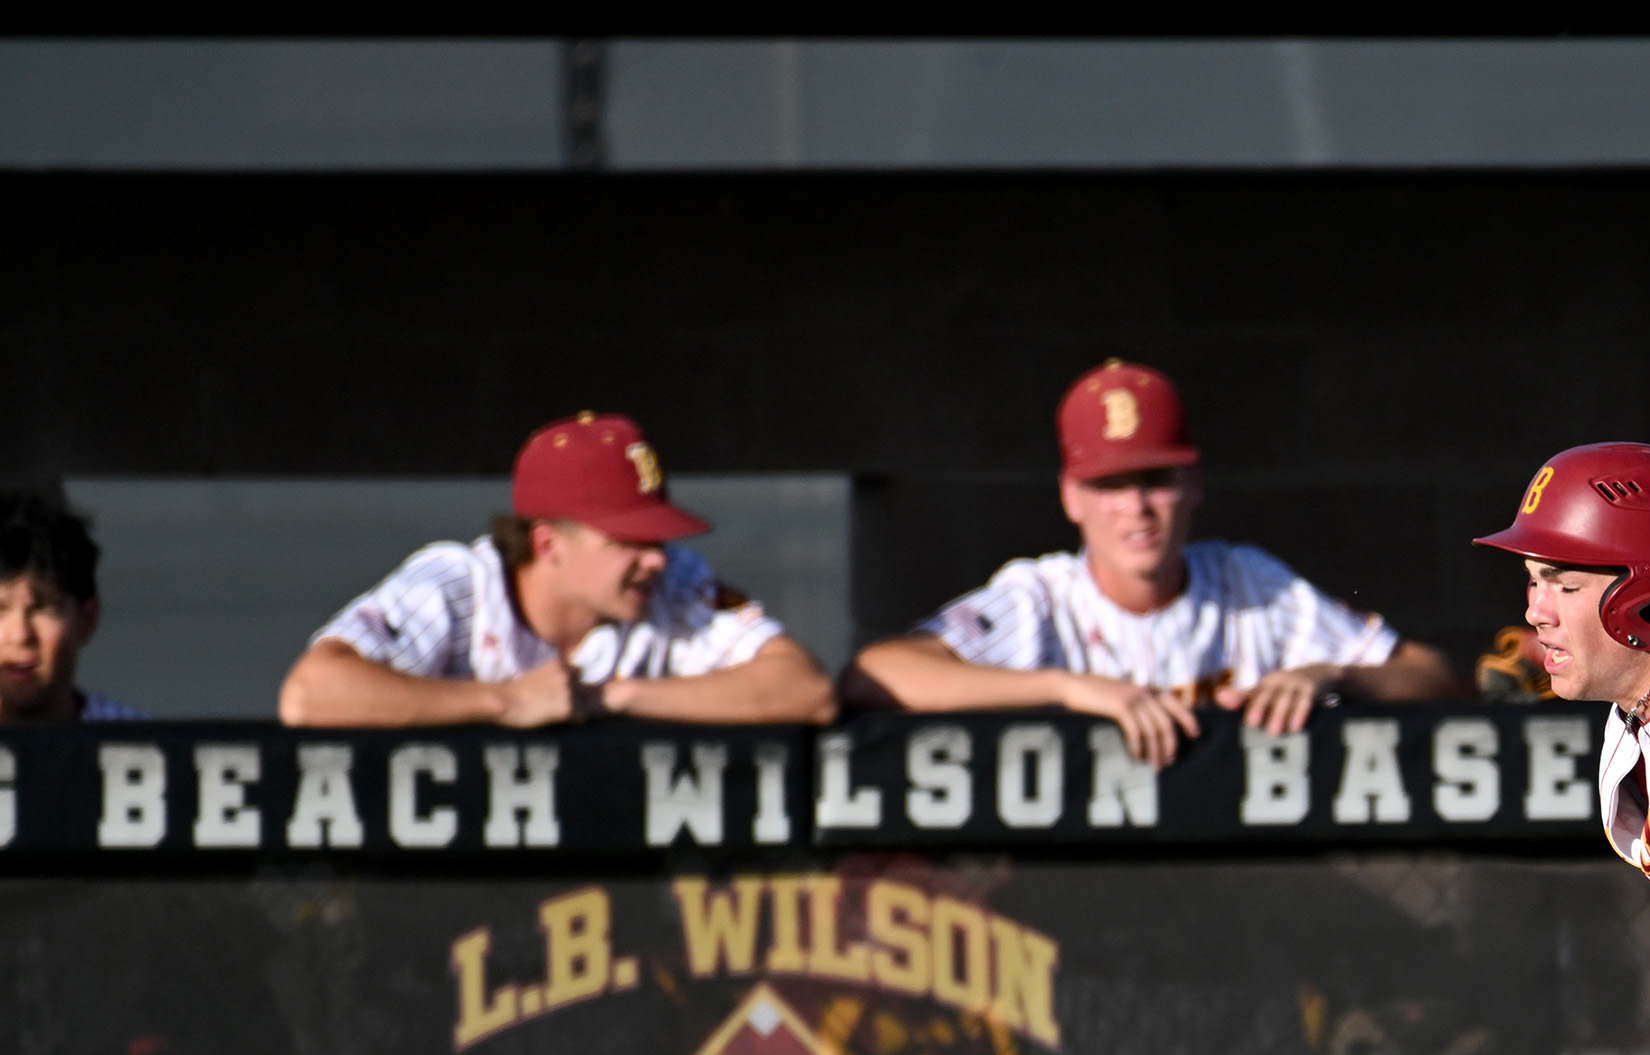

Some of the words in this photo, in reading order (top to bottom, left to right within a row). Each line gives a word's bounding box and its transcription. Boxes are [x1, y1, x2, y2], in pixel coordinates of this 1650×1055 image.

[1522, 466, 1555, 514] B
[97, 742, 562, 848] BEACH
[641, 722, 1160, 846] WILSON
[450, 884, 641, 1055] L.B.
[671, 872, 1062, 1053] WILSON
